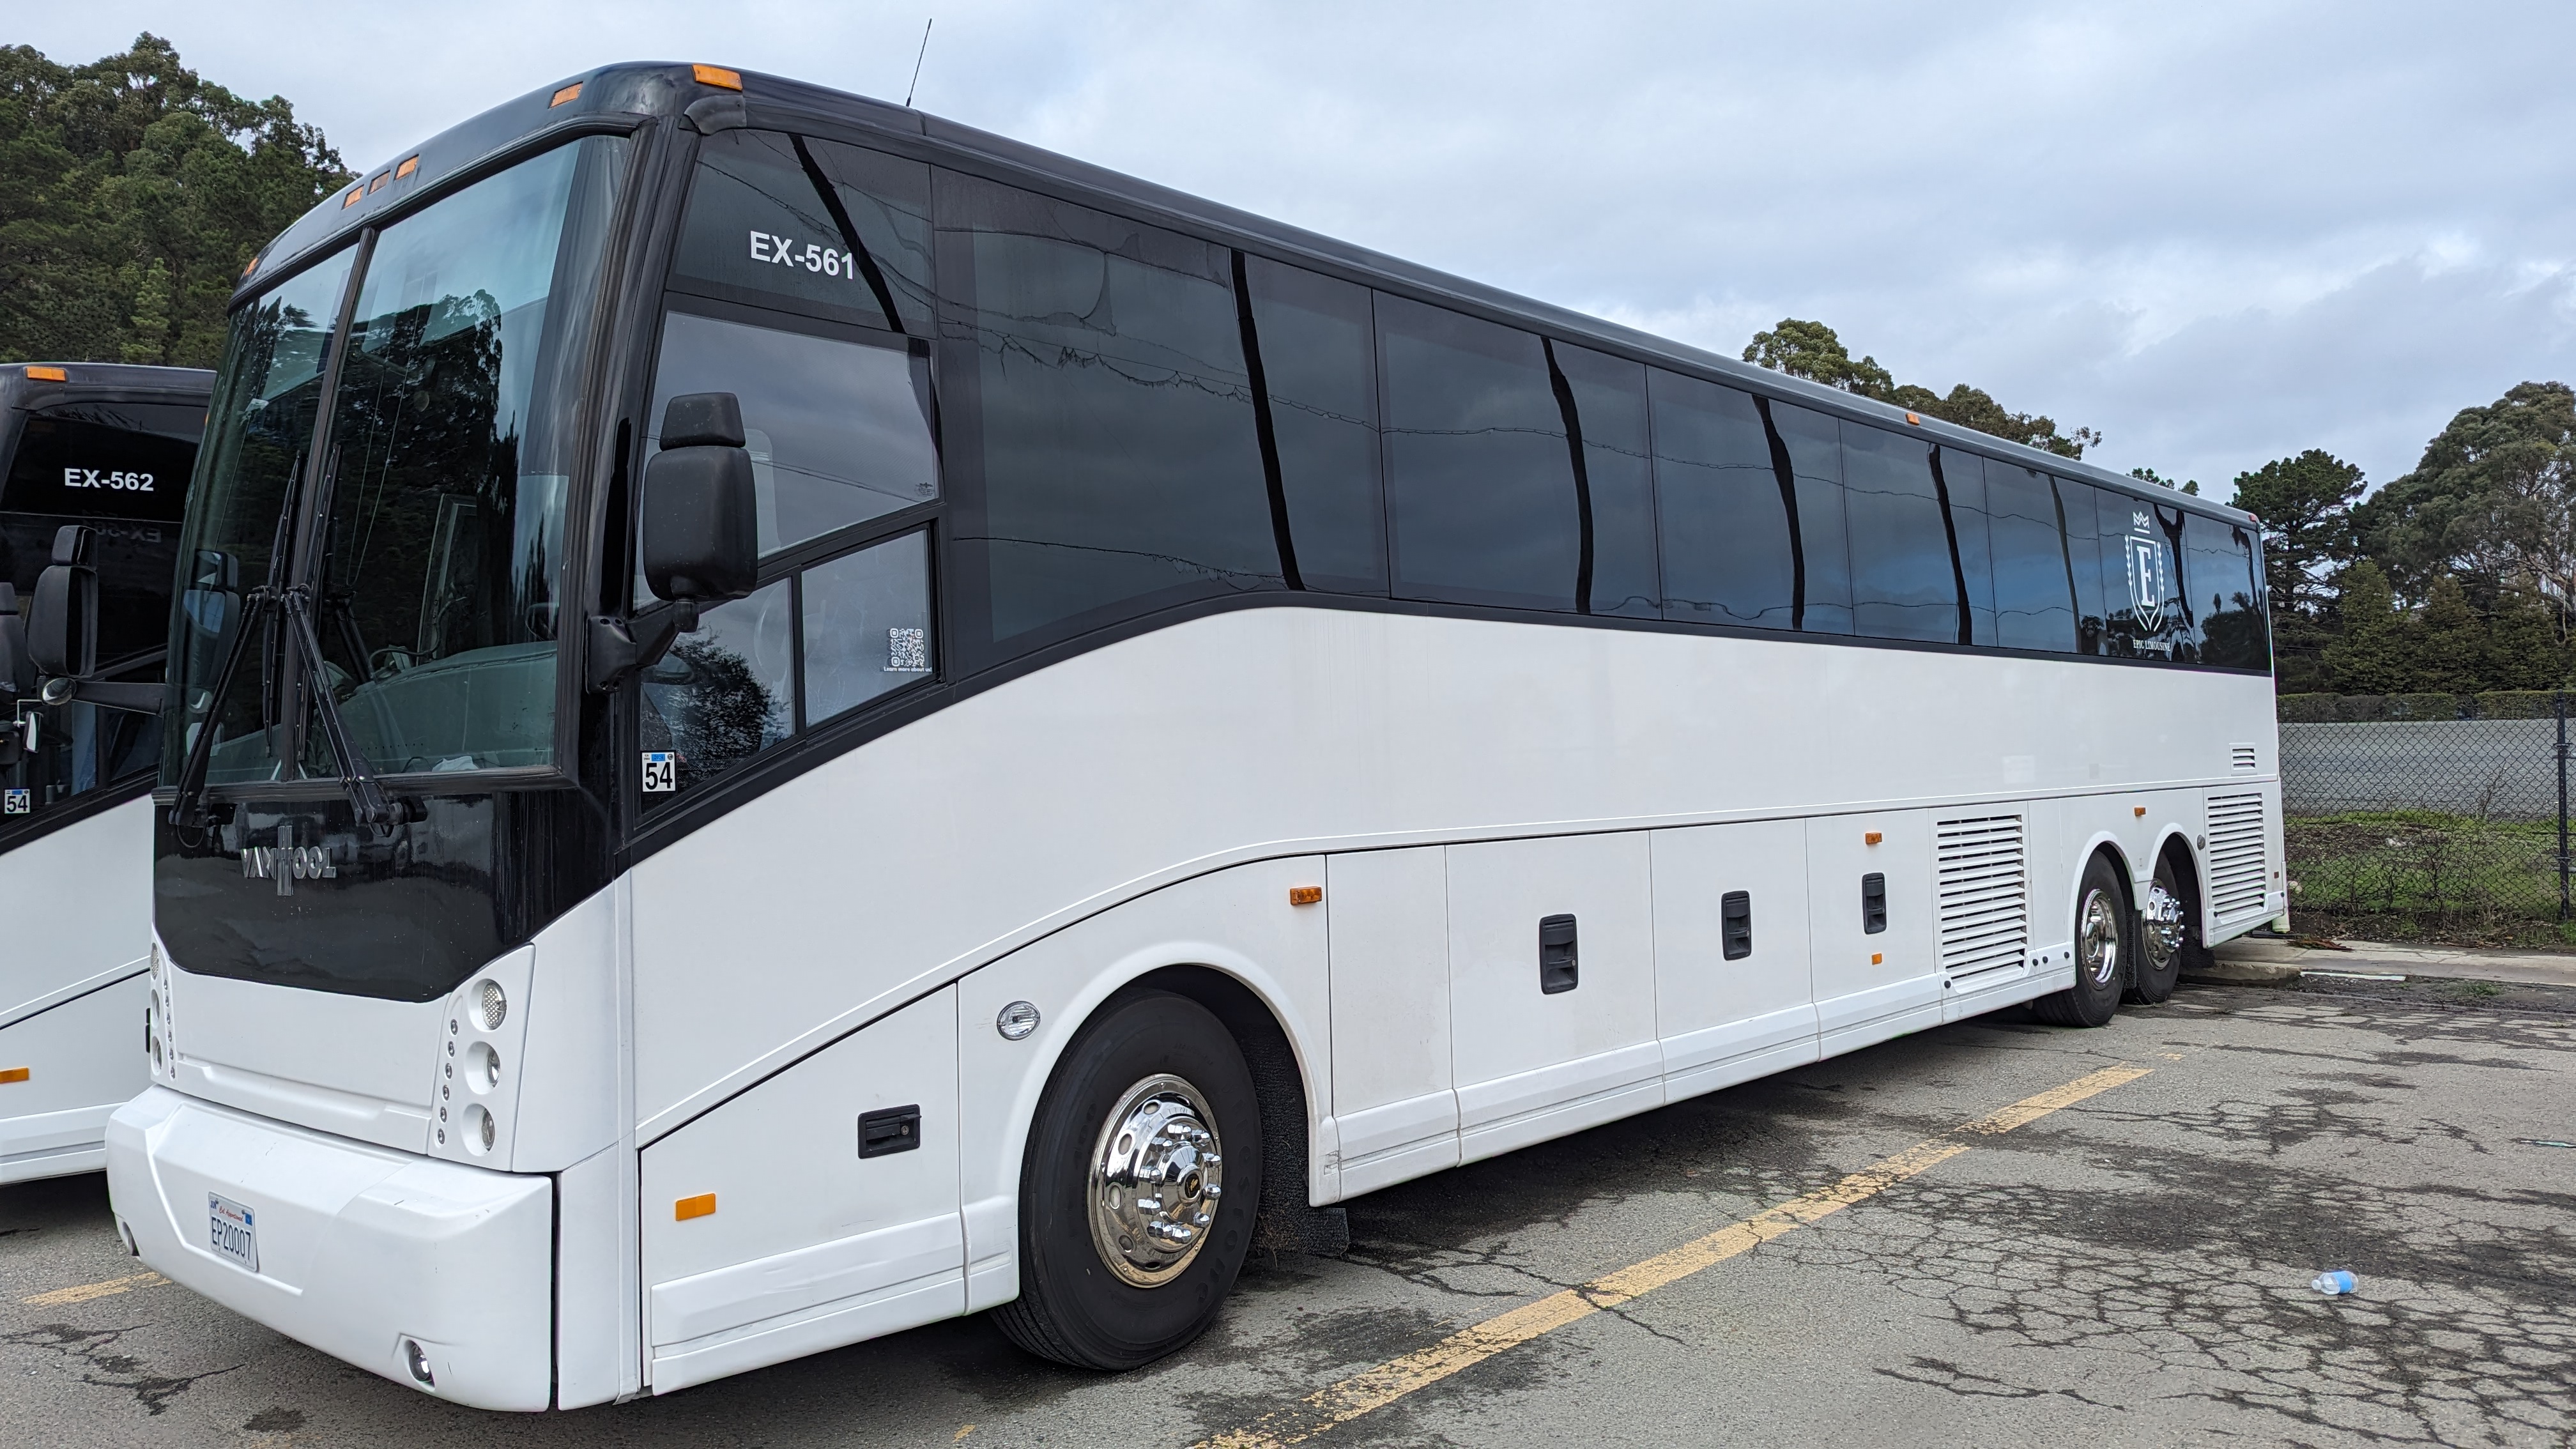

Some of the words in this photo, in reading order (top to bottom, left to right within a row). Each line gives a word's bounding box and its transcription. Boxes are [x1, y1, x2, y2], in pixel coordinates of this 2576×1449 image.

[750, 230, 854, 280] EX-561
[64, 468, 154, 491] EX-562
[2136, 546, 2156, 608] E
[2133, 639, 2144, 649] EPIC
[2145, 640, 2171, 652] LIMOUSINE
[645, 762, 673, 790] 54
[6, 795, 28, 813] 54
[211, 1216, 252, 1261] EP20007
